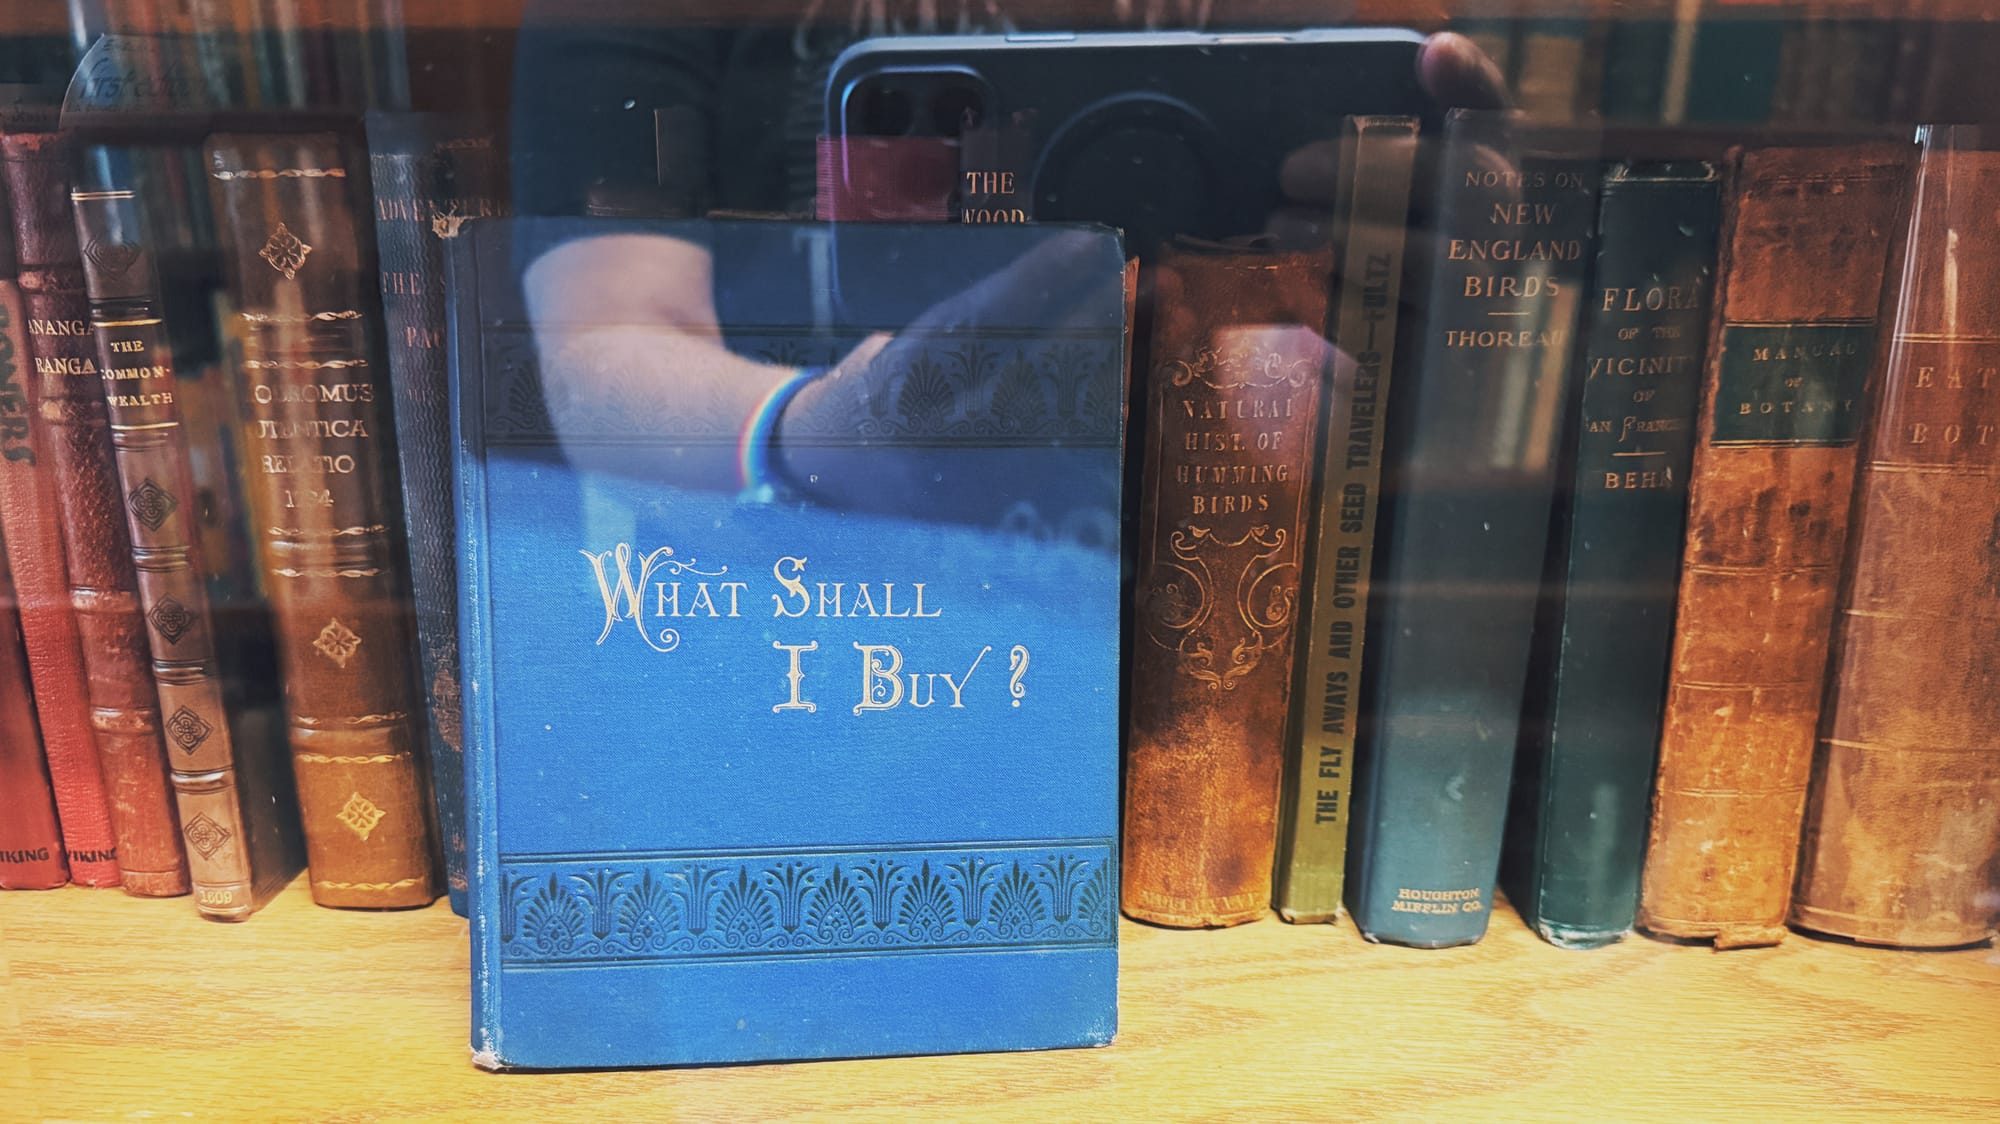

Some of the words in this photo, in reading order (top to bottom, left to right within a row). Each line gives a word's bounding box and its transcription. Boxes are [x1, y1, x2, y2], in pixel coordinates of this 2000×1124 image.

[966, 171, 1015, 194] THE
[1465, 171, 1545, 188] NOTES
[1555, 172, 1583, 188] ON
[1489, 203, 1557, 225] NEW
[1447, 239, 1582, 261] ENGLAND
[1464, 276, 1560, 297] BIRDS
[1446, 330, 1563, 348] THOREAU
[1618, 327, 1640, 340] OF
[111, 340, 144, 353] THE
[1752, 343, 1857, 361] MANUAL
[35, 357, 97, 375] RANGA
[1914, 366, 1997, 389] EAT
[106, 392, 173, 407] WEALTH
[1633, 390, 1656, 403] OF
[1739, 399, 1854, 415] BOTANY
[1185, 432, 1247, 451] HIST.
[1257, 431, 1284, 450] OF
[1909, 423, 1995, 445] BOT
[1177, 464, 1288, 485] HUMMING
[1192, 495, 1270, 515] BIRDS
[1339, 483, 1367, 534] SEED
[1332, 546, 1361, 609] OTHER
[1328, 621, 1353, 659] AND
[772, 640, 819, 714] I
[1322, 671, 1349, 735] AWAYS
[1318, 746, 1343, 779] FLY
[1315, 790, 1339, 824] THE
[1398, 888, 1480, 901] HOUGHTON
[1391, 900, 1458, 914] MIFFLIN
